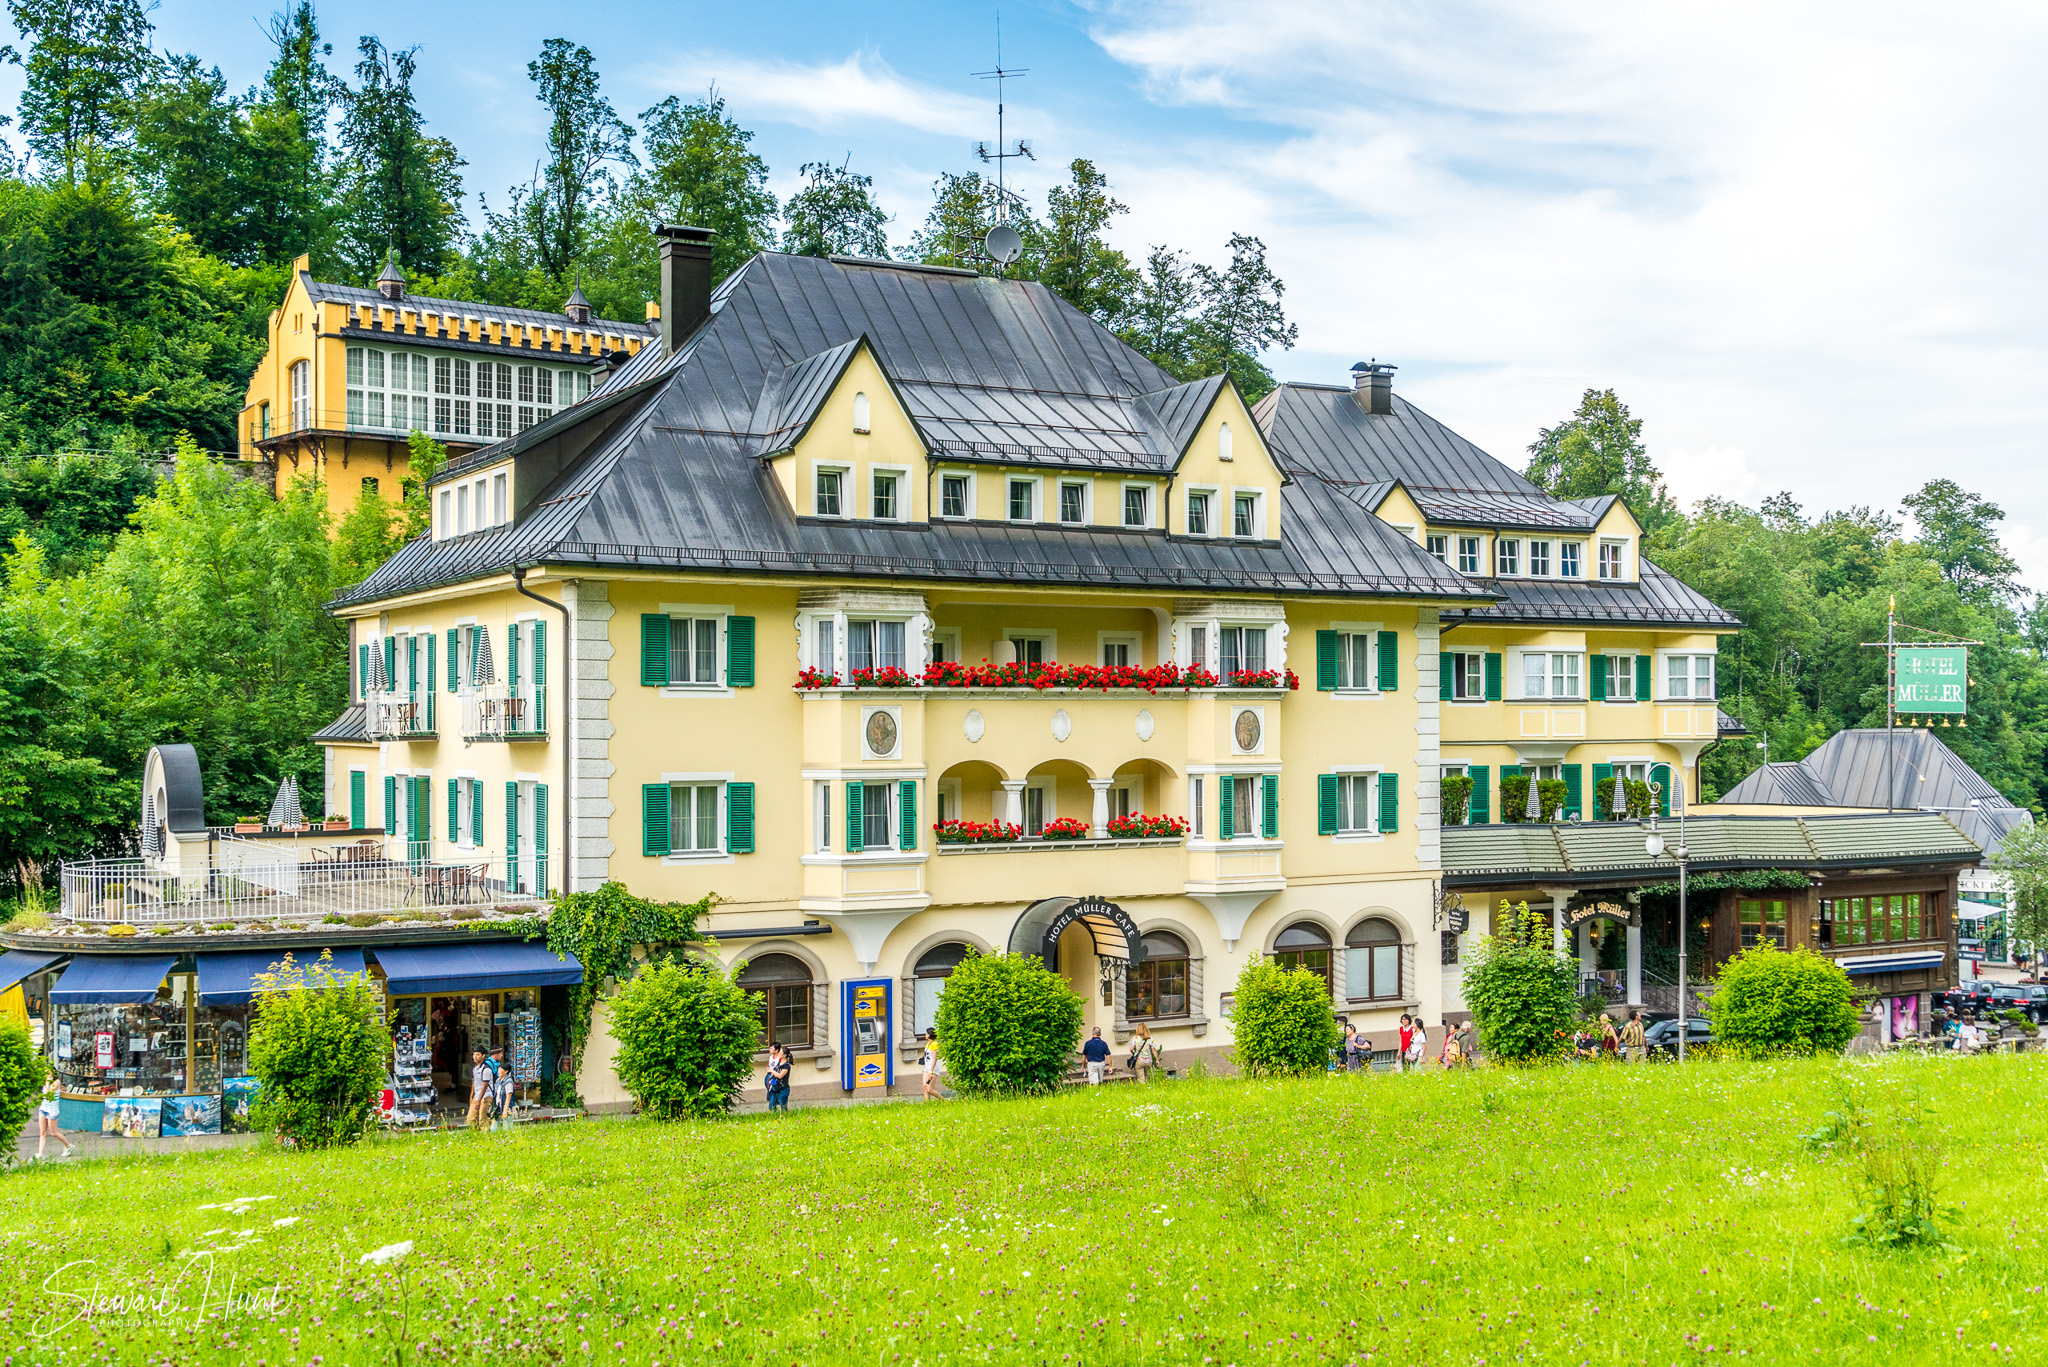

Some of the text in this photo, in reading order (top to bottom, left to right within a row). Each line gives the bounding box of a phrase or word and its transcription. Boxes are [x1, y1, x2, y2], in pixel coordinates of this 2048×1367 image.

[1905, 657, 1958, 675] HOTEL
[1897, 681, 1964, 702] MÜLLER
[1049, 903, 1135, 943] HOTEL MÜLLER CAFE
[1570, 901, 1631, 925] Hotel Müller
